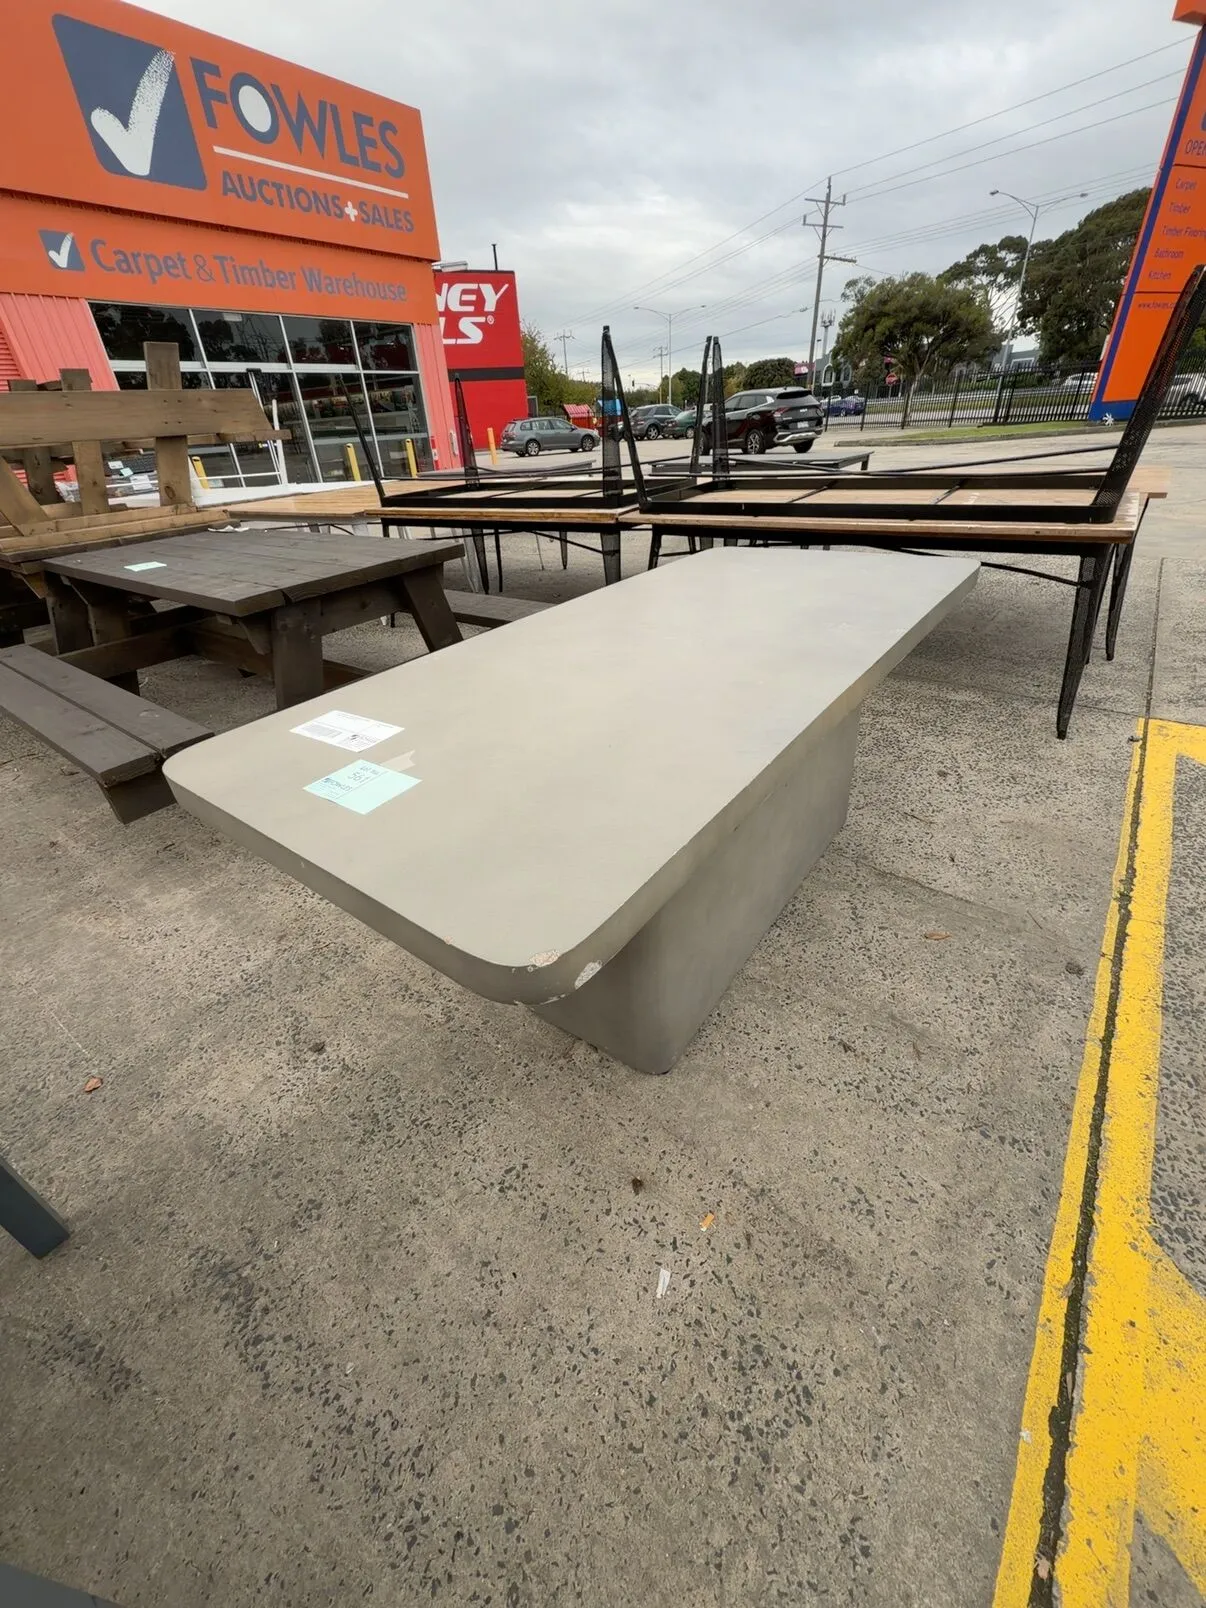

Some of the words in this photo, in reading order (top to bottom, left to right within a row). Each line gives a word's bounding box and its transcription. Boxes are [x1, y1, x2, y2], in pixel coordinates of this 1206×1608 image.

[190, 57, 406, 179] FOWLES
[90, 238, 192, 284] Carpet
[195, 254, 216, 282] &
[213, 255, 297, 291] Timber
[301, 265, 407, 301] Warehouse
